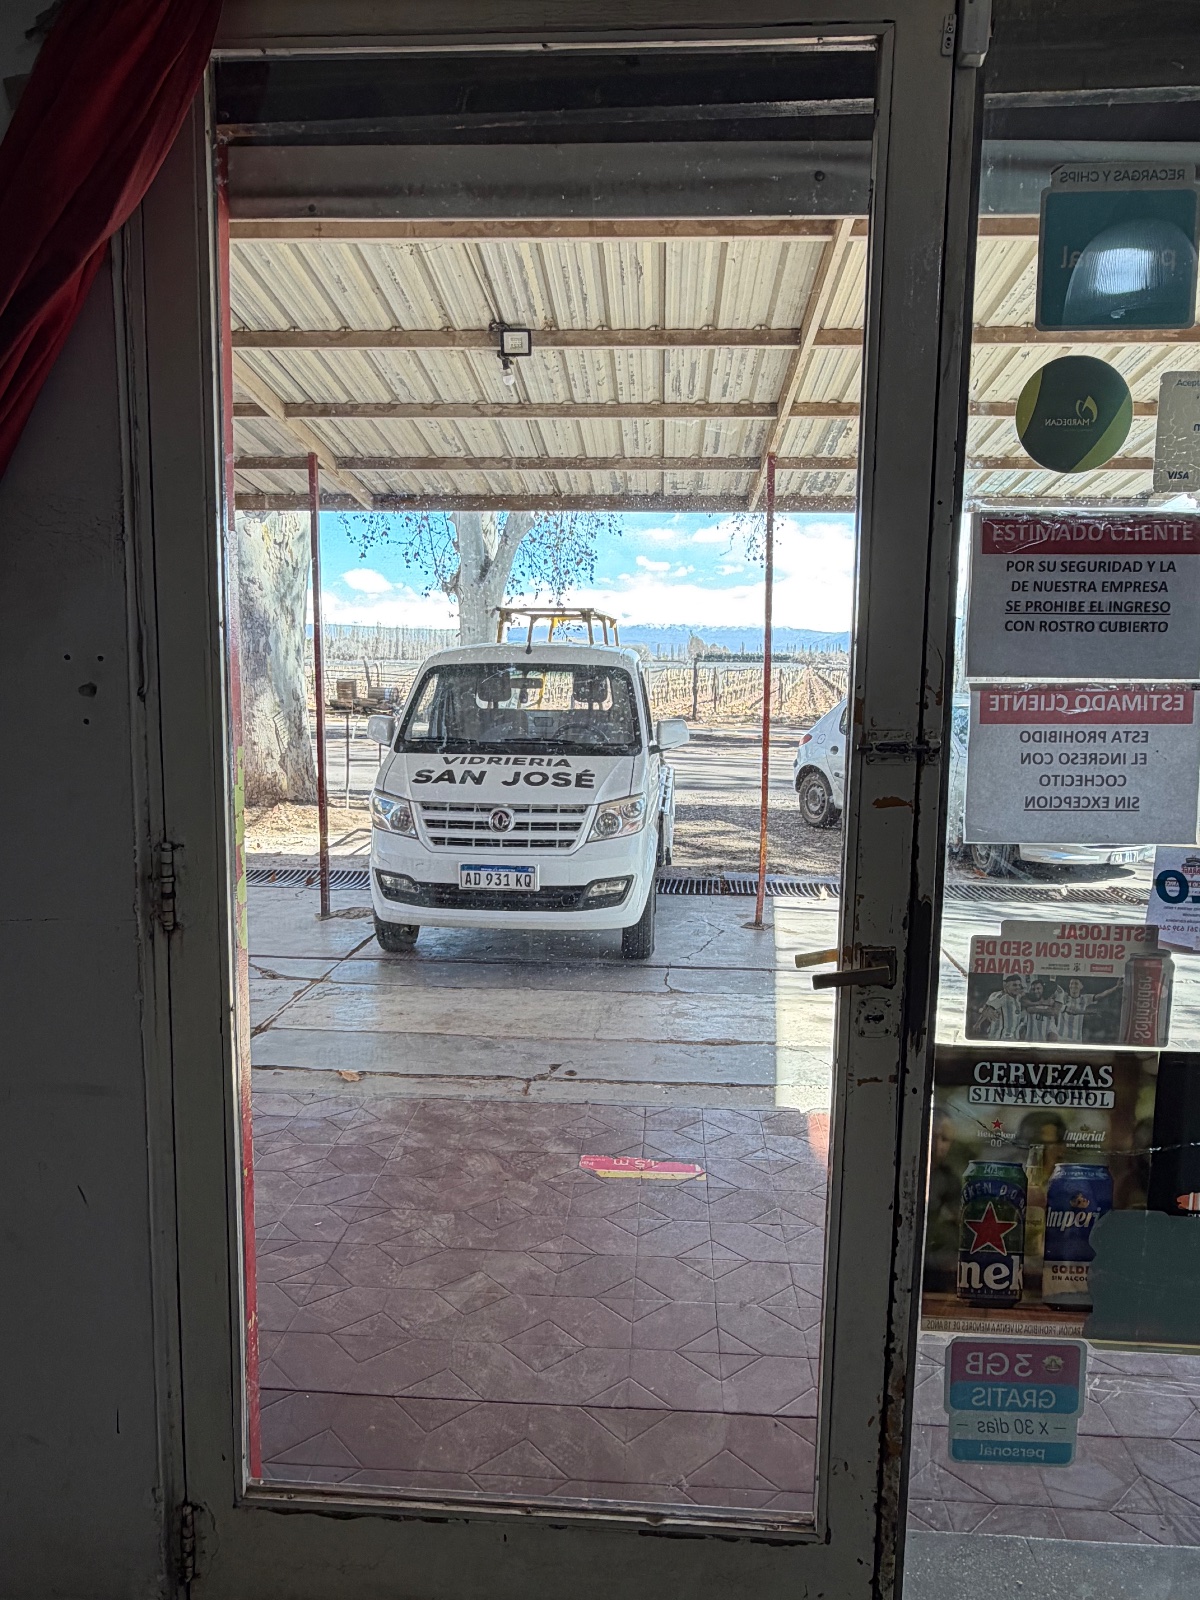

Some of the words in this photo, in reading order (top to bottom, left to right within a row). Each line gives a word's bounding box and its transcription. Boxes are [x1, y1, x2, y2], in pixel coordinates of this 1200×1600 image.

[1168, 471, 1189, 480] VISA
[993, 524, 1106, 541] ESTIMADO
[1110, 524, 1194, 541] CLIENTE
[1006, 560, 1034, 572] POR
[1038, 560, 1056, 572] SU
[1060, 560, 1142, 572] SEGURIDAD
[1146, 561, 1156, 572] Y
[1159, 561, 1176, 572] LA
[1011, 580, 1029, 592] DE
[1032, 580, 1097, 592] NUESTRA
[1101, 581, 1168, 592] EMPRESA
[1005, 600, 1020, 613] SE
[1025, 600, 1085, 613] PROHIBE
[1090, 600, 1104, 613] EL
[1108, 600, 1171, 613] INGRESO
[1004, 620, 1034, 632] CON
[1039, 620, 1095, 632] ROSTRO
[1099, 620, 1168, 632] CUBIERTO
[442, 756, 572, 768] VIDRIERIA
[412, 769, 488, 786] SAN
[501, 769, 596, 789] JOSÉ
[464, 872, 481, 886] AD
[486, 873, 510, 886] 931
[516, 874, 532, 888] KQ
[974, 1062, 1113, 1088] CERVEZAS
[972, 1088, 1005, 1102] SIN
[1014, 1090, 1110, 1106] ALCOHOL
[1063, 1130, 1106, 1142] Imperial
